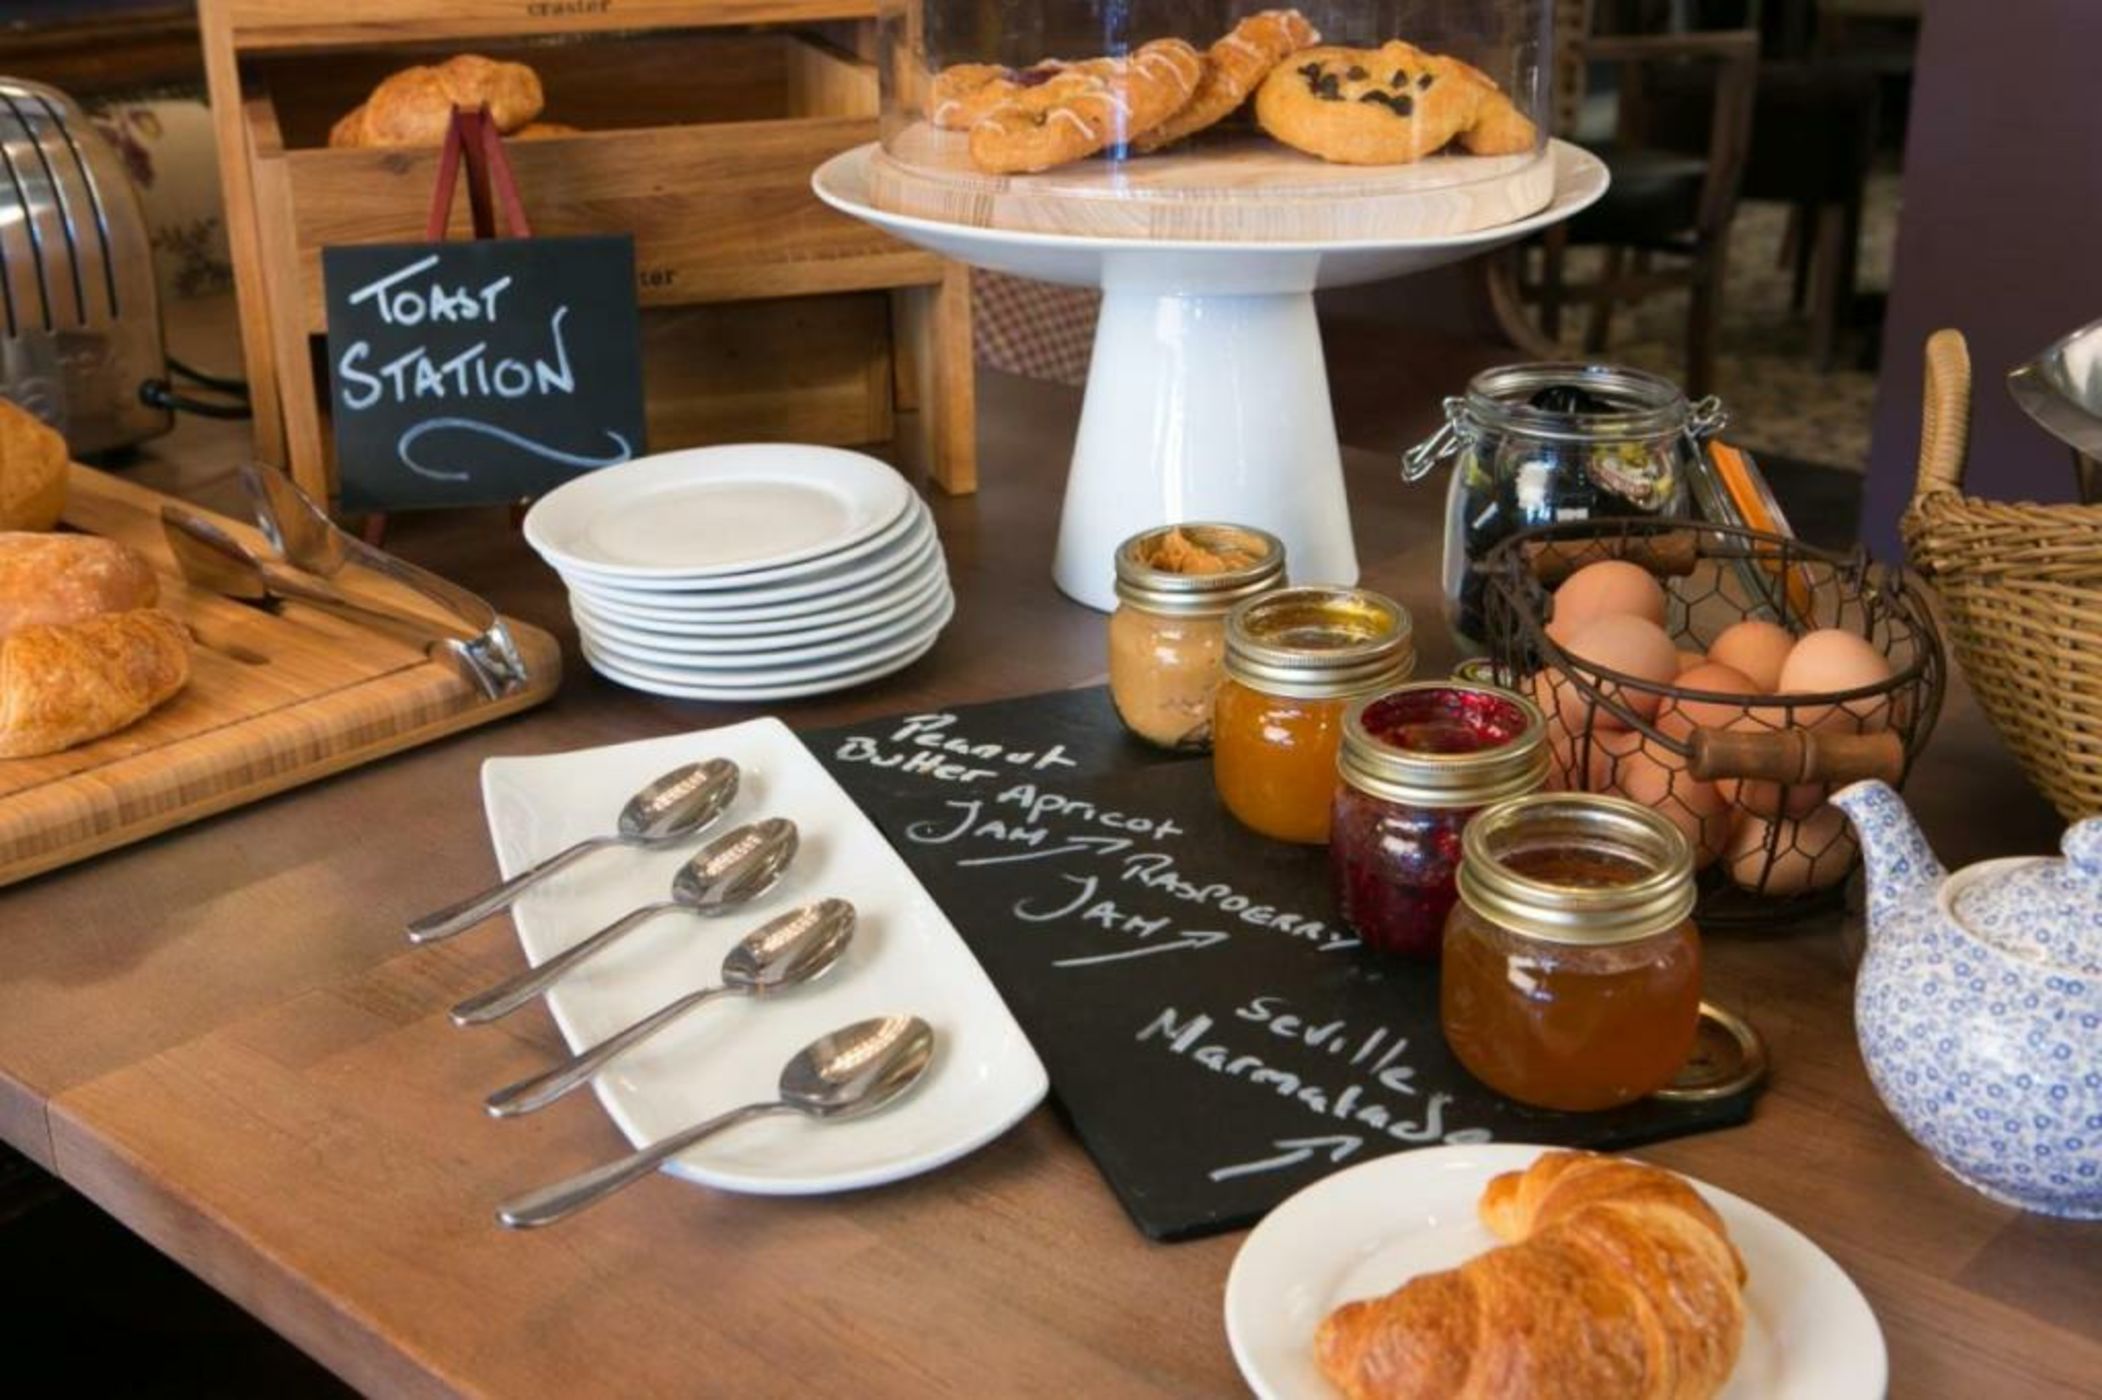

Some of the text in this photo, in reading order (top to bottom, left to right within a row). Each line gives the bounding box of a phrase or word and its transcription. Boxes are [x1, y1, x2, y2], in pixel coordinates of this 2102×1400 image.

[349, 254, 512, 325] TOAST
[338, 305, 576, 410] STATION
[835, 736, 999, 782] Butter
[890, 713, 1078, 770] Peanut
[905, 800, 1049, 846] JAM
[996, 783, 1184, 840] Apricot
[1013, 873, 1173, 937] JAM
